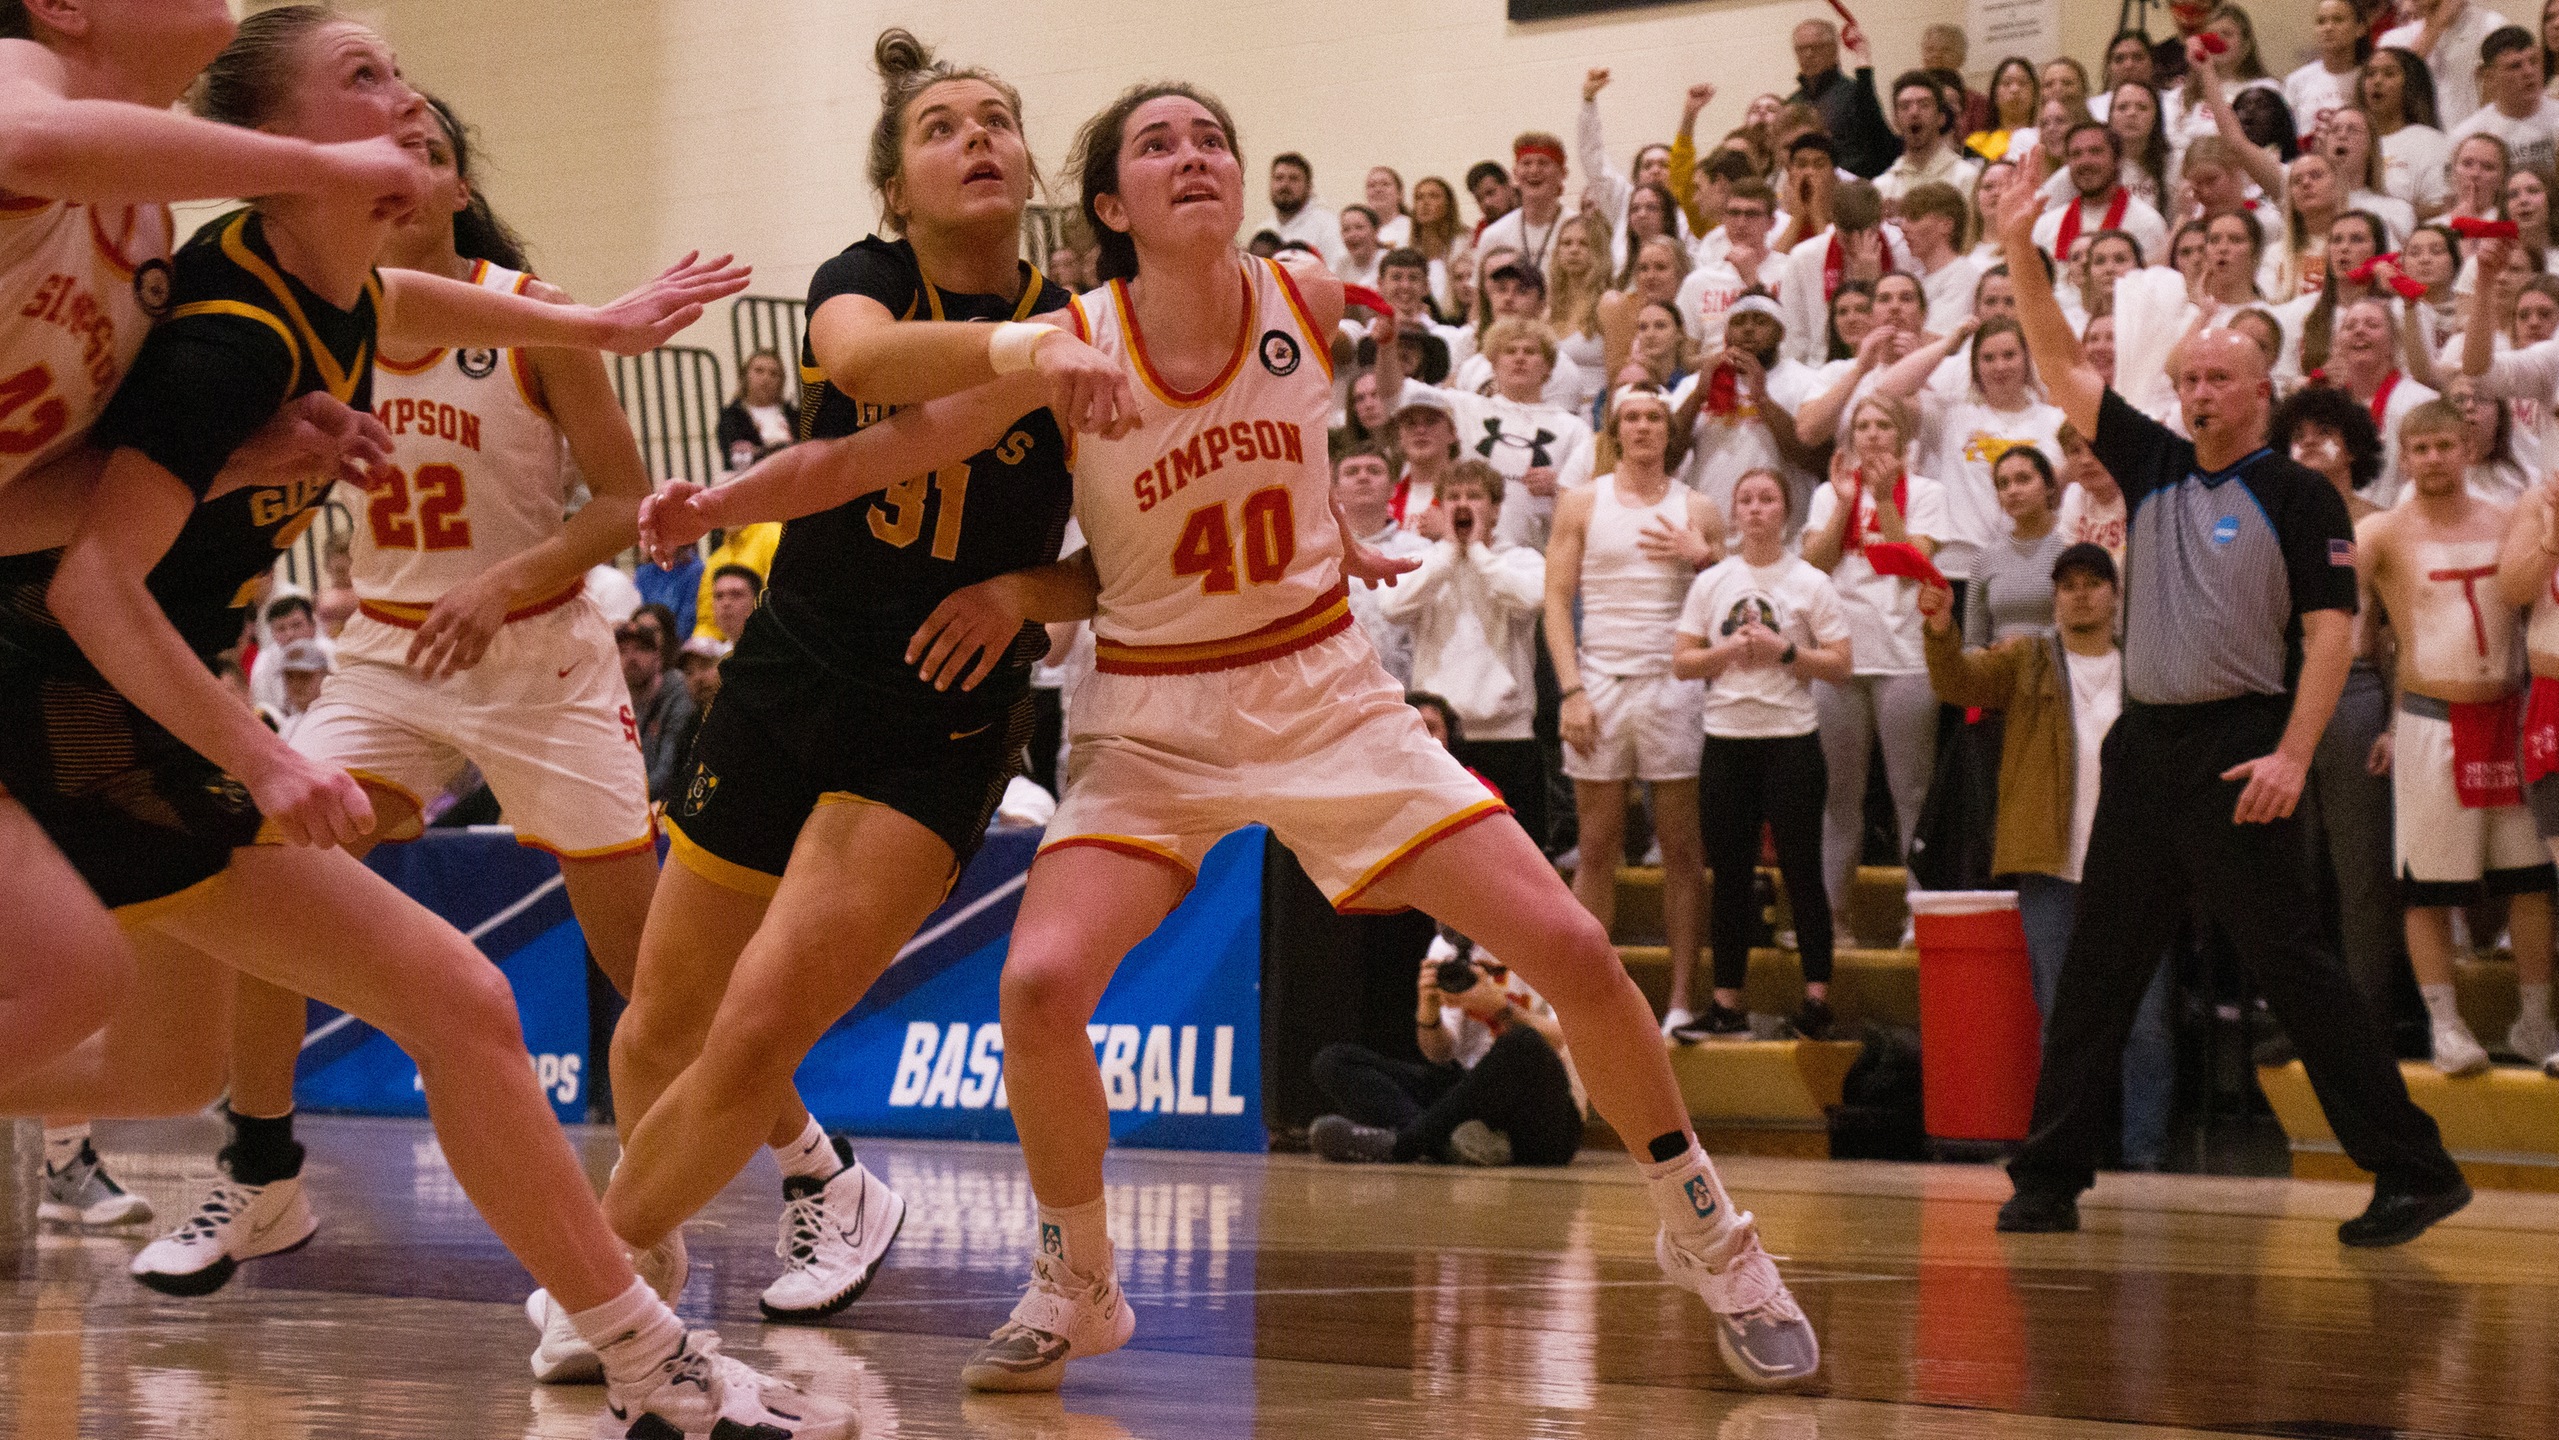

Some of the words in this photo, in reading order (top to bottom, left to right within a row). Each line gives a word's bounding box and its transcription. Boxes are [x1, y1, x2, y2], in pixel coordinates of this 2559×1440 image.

[365, 462, 473, 552] 22
[866, 459, 971, 562] 31
[1133, 420, 1303, 513] SIMPSON
[1170, 483, 1297, 597] 40
[2428, 564, 2499, 657] T
[888, 1021, 1246, 1115] BASBALL
